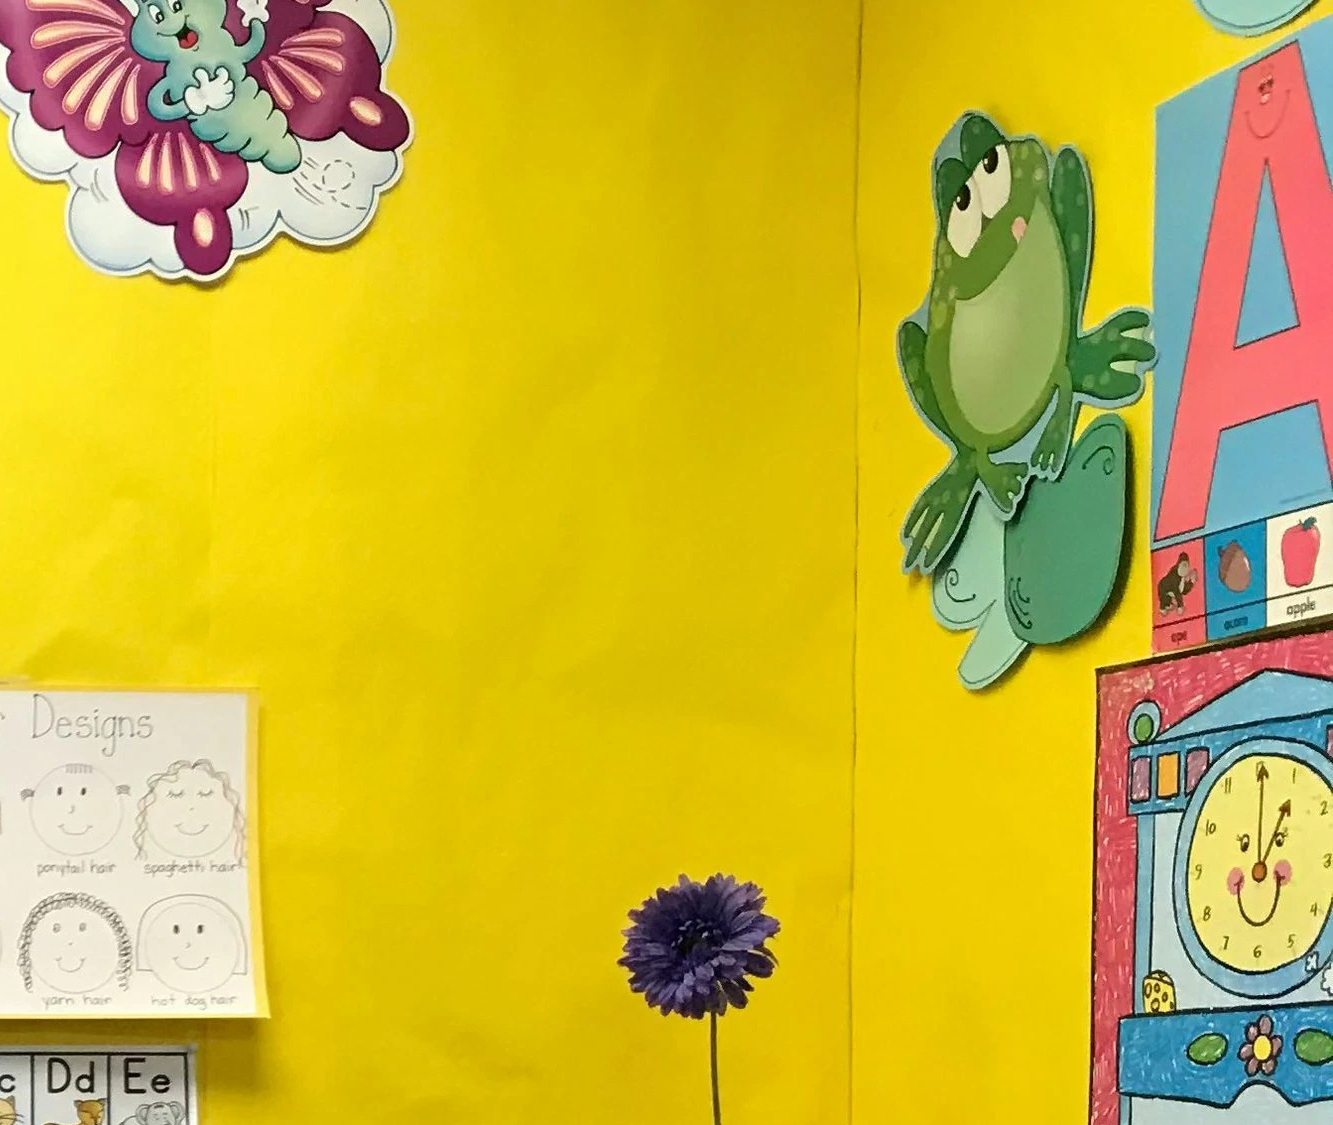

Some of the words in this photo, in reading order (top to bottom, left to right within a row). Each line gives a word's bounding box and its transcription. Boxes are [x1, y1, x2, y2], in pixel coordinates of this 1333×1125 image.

[1155, 40, 1333, 541] A
[1286, 597, 1315, 618] apple
[31, 693, 153, 756] Designs
[1224, 777, 1231, 794] 11
[1321, 801, 1328, 815] 2
[1206, 822, 1216, 836] 10
[1324, 854, 1332, 868] 3
[36, 860, 85, 877] ponytail
[90, 860, 116, 874] hair
[143, 860, 204, 878] spaghetti
[210, 861, 237, 873] hair
[1195, 865, 1203, 880] 9
[1203, 907, 1211, 921] 8
[1310, 903, 1318, 916] 4
[1223, 936, 1229, 950] 7
[1288, 934, 1295, 948] 5
[1254, 944, 1261, 958] 6
[43, 994, 76, 1008] yarn
[83, 994, 111, 1006] hair
[186, 995, 208, 1010] dog
[211, 994, 236, 1005] hair
[48, 1058, 95, 1093] Dd
[124, 1058, 171, 1094] Ee
